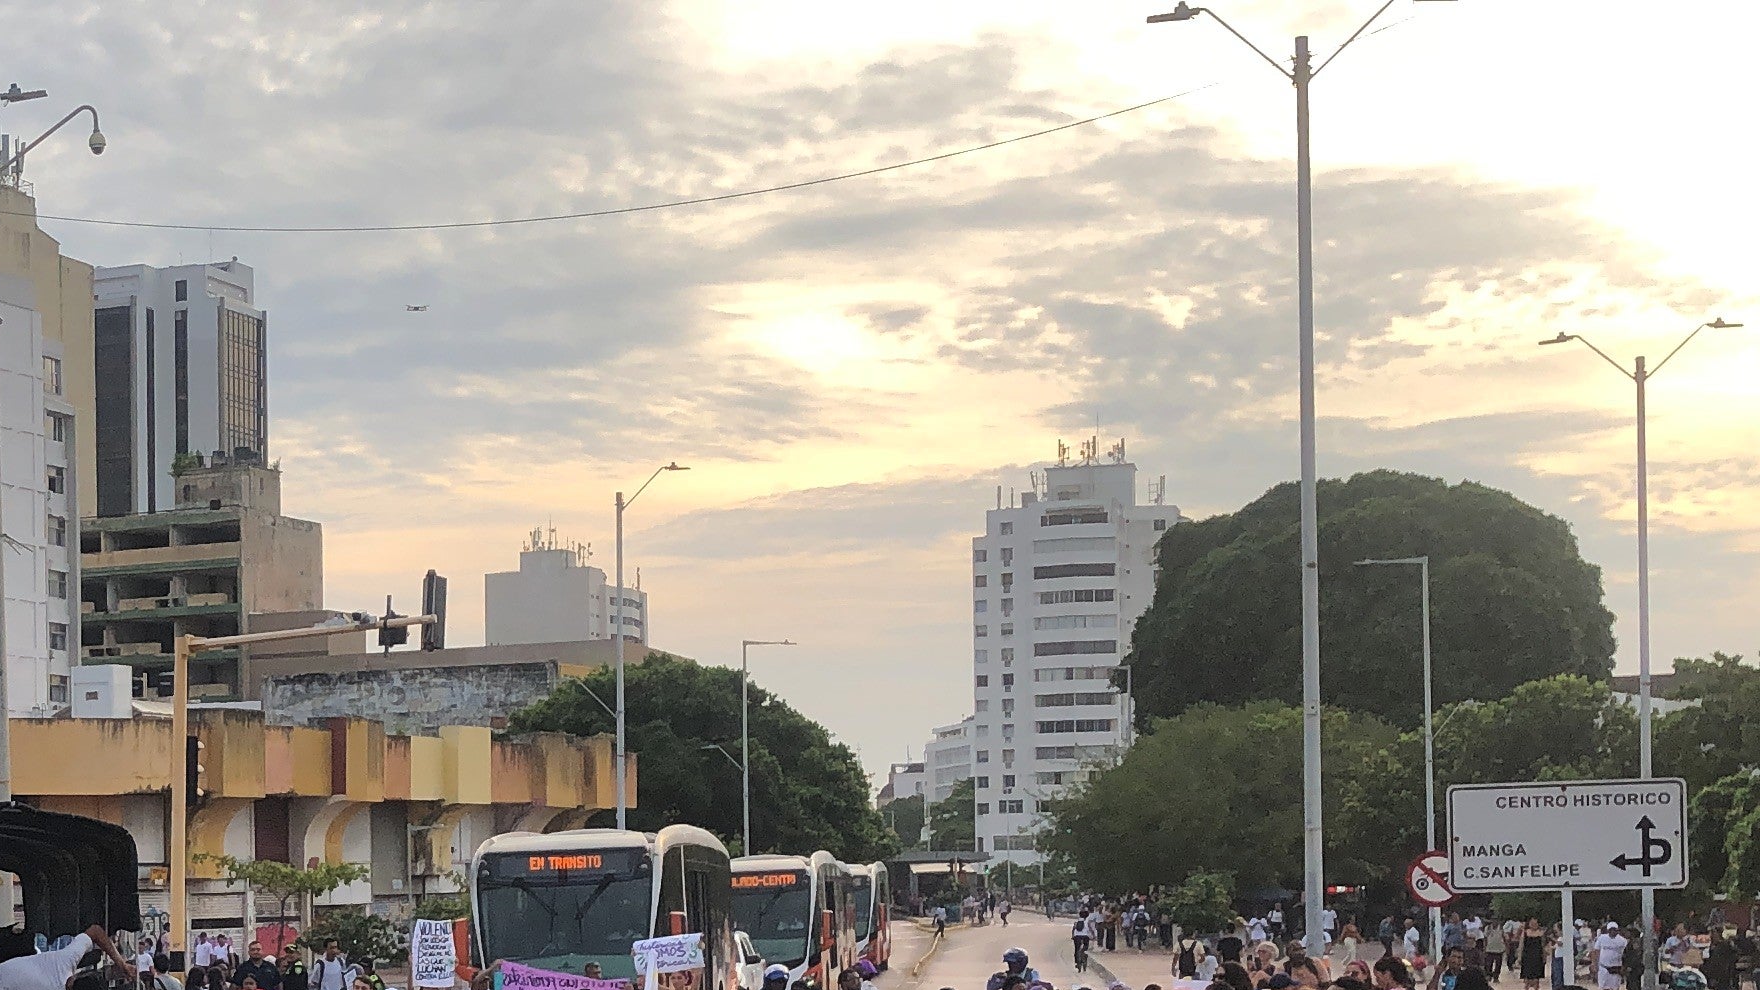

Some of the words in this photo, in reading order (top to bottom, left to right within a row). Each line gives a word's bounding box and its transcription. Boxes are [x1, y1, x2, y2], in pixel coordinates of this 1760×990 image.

[1495, 794, 1568, 809] CENTRO
[1573, 791, 1671, 807] HISTORICO
[1462, 843, 1527, 858] MANGA
[529, 856, 545, 871] EN
[548, 854, 602, 870] TRANSITO
[1520, 863, 1580, 878] FELIPE
